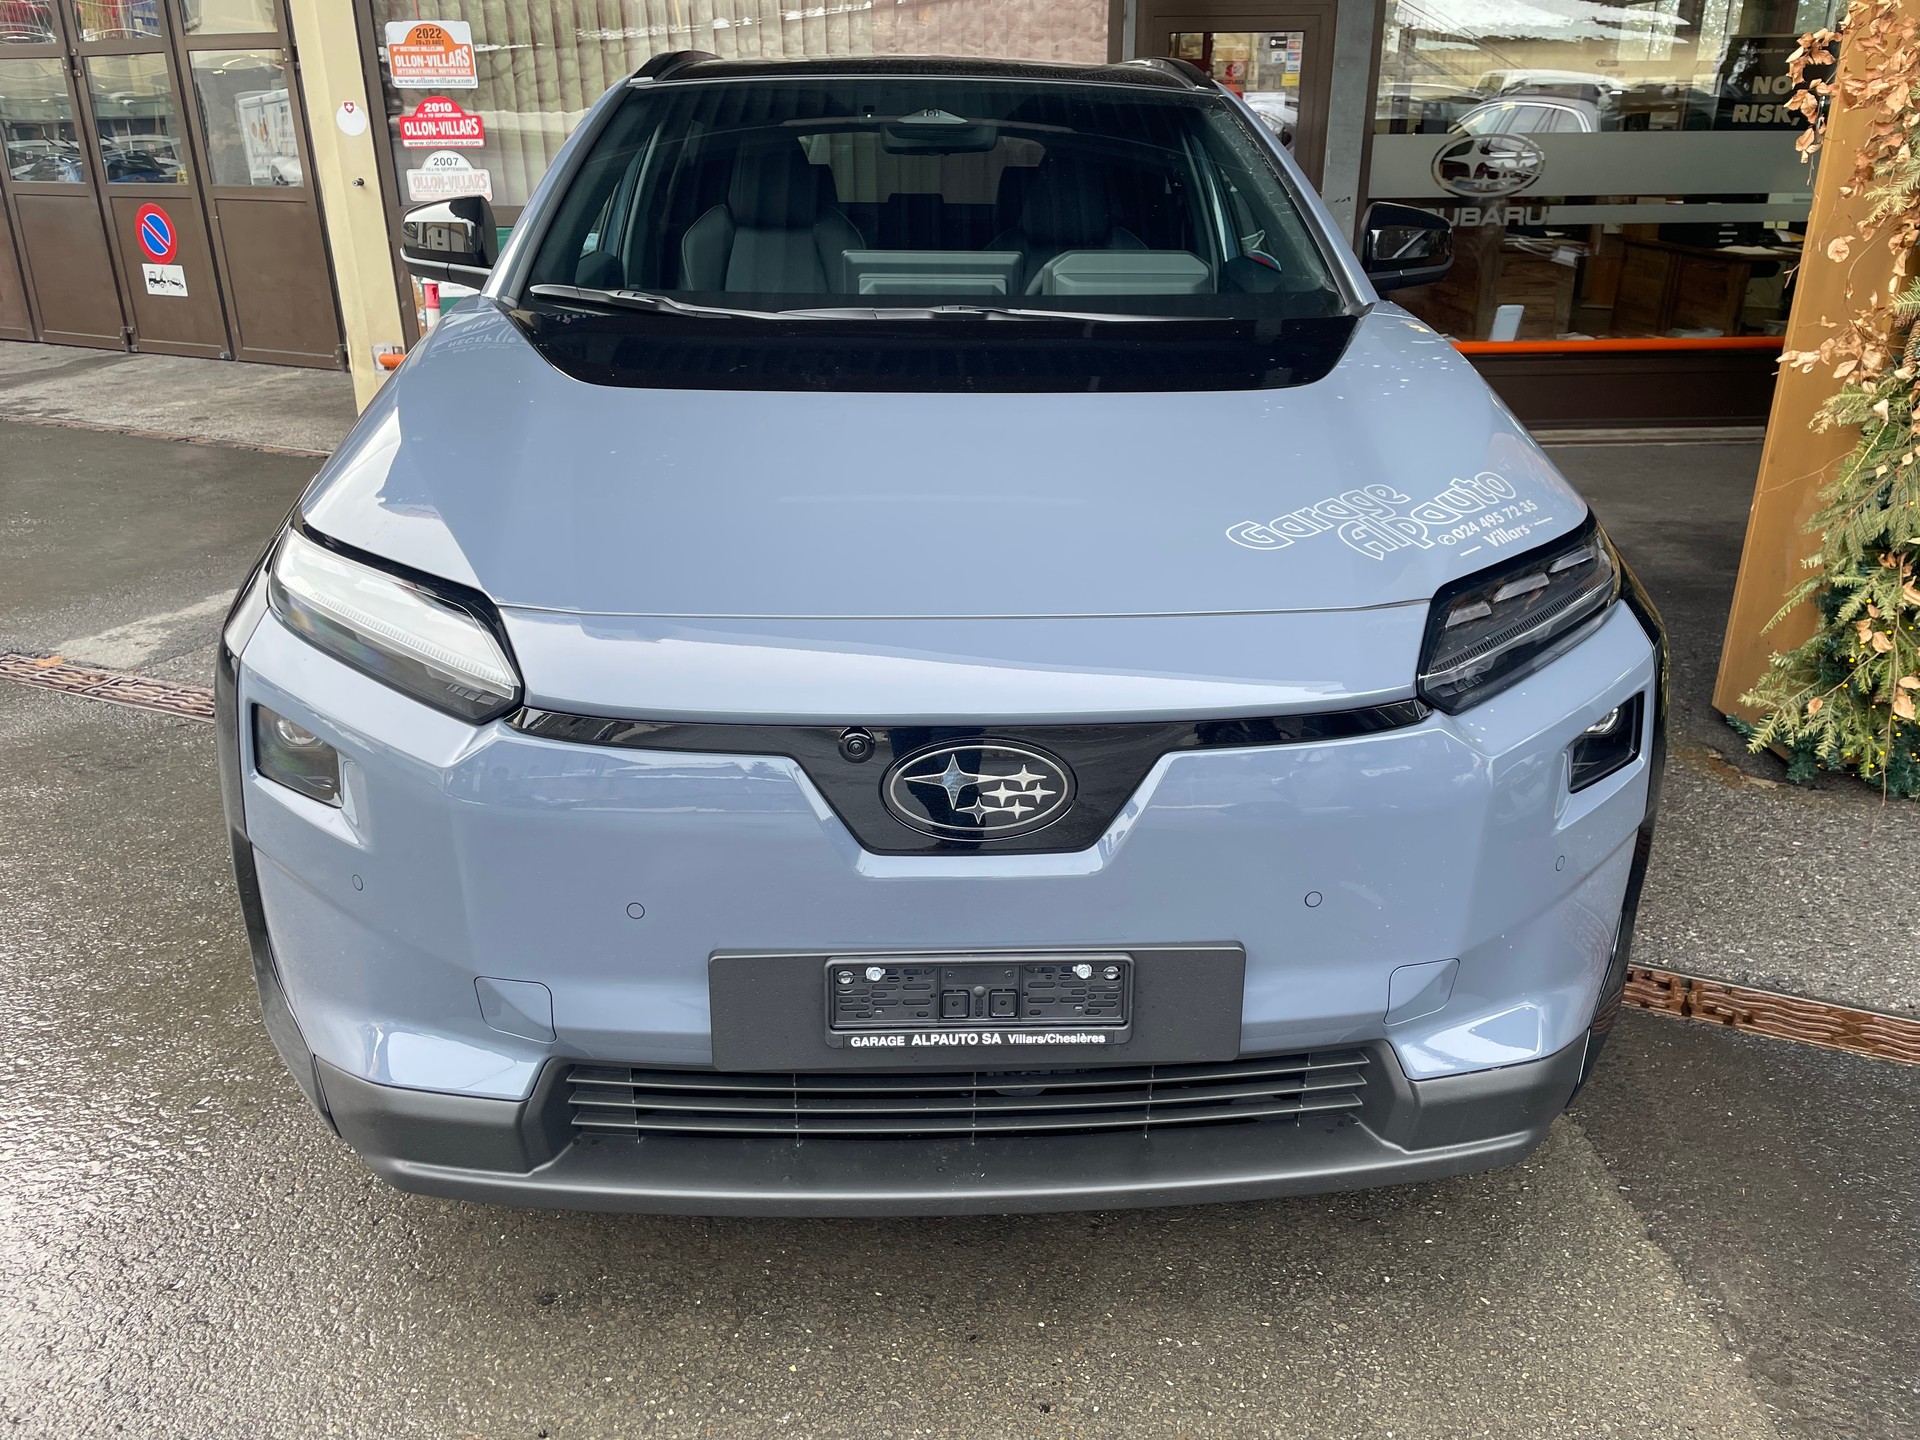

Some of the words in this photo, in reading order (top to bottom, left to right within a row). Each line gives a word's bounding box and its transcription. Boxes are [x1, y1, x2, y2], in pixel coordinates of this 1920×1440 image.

[415, 28, 442, 39] 2022
[394, 45, 471, 68] OLLON-VILLARS
[1752, 76, 1793, 95] NO
[424, 102, 453, 112] 2010
[1732, 104, 1801, 126] RISK,
[403, 117, 480, 136] OLLON-VILLARS
[433, 157, 459, 166] 2007
[412, 173, 488, 190] OLLON-VILLARS
[1225, 484, 1412, 551] Garage
[1337, 471, 1517, 561] Alpauto
[1451, 521, 1480, 540] 024
[1479, 511, 1505, 528] 495
[1501, 504, 1523, 520] 72
[1519, 499, 1538, 513] 35
[1482, 523, 1531, 547] Villars
[850, 1035, 906, 1047] GARAGE
[911, 1033, 979, 1046] ALPAUTO
[981, 1033, 1002, 1045] SA
[1008, 1033, 1106, 1045] Villars/Chesières
